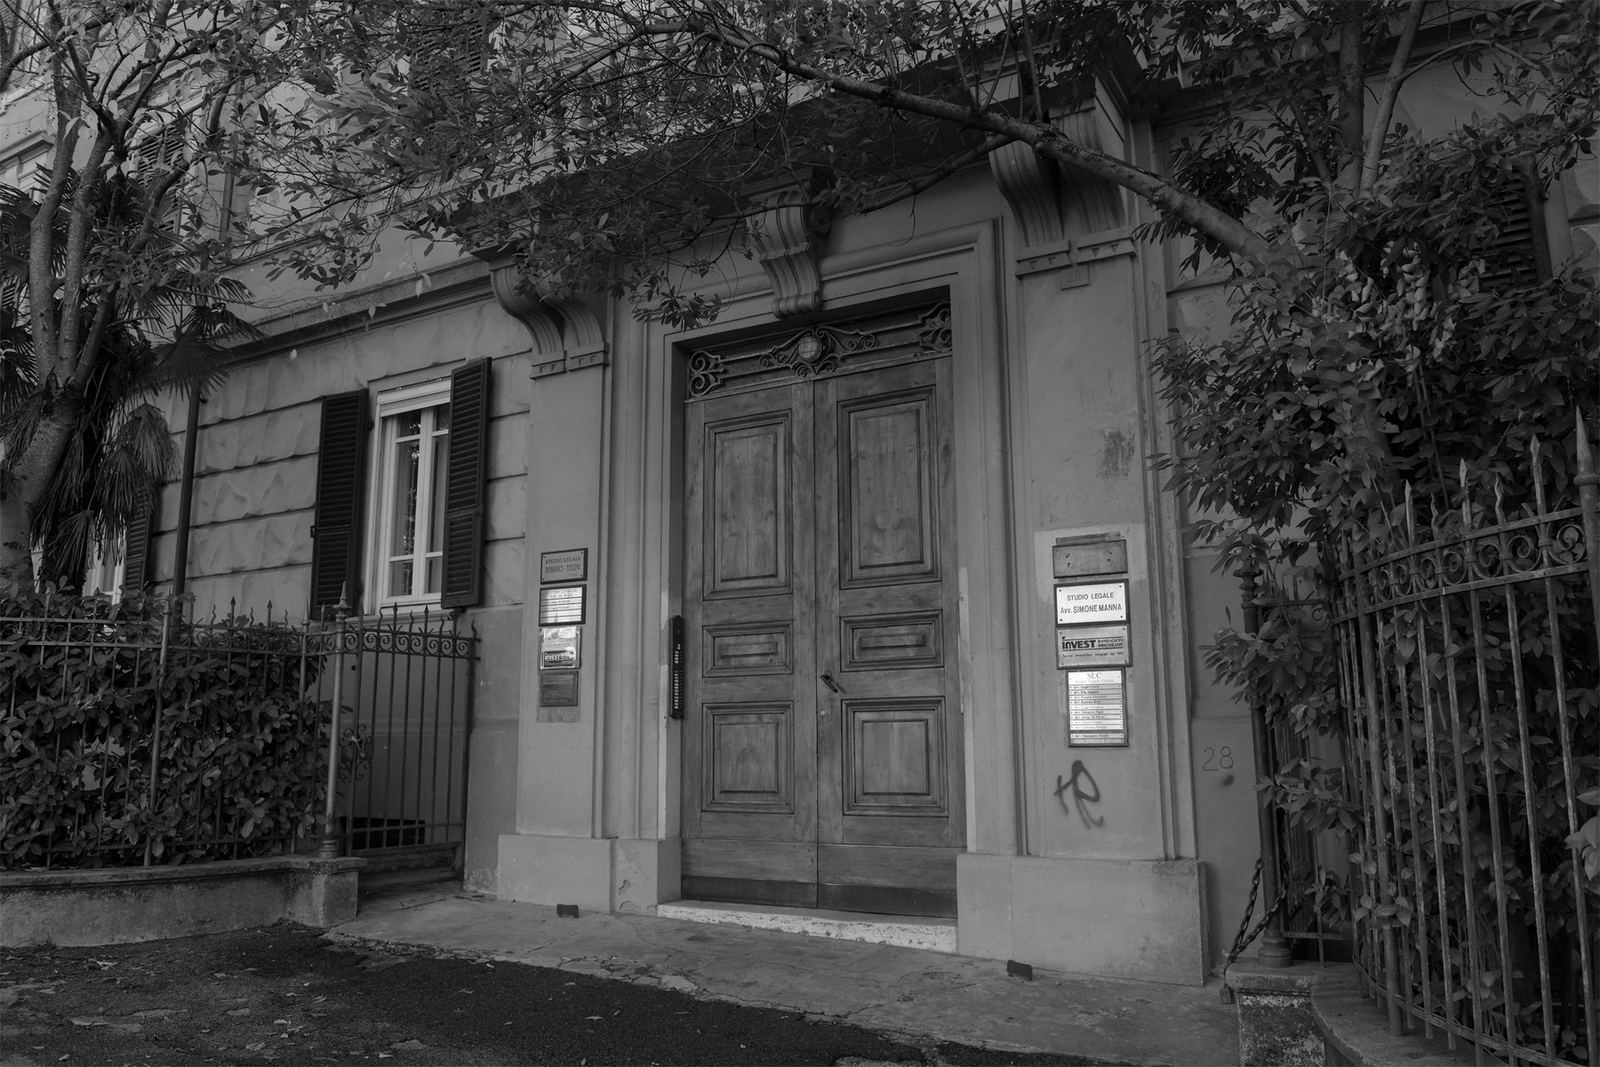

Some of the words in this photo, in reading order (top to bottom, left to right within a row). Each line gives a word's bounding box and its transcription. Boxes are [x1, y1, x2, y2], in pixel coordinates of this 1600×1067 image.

[1066, 594, 1089, 602] STUDIO
[1091, 592, 1114, 600] LEGALE
[1073, 604, 1098, 613] SIMONE
[1098, 603, 1122, 611] MANNA
[1202, 746, 1234, 772] 28
